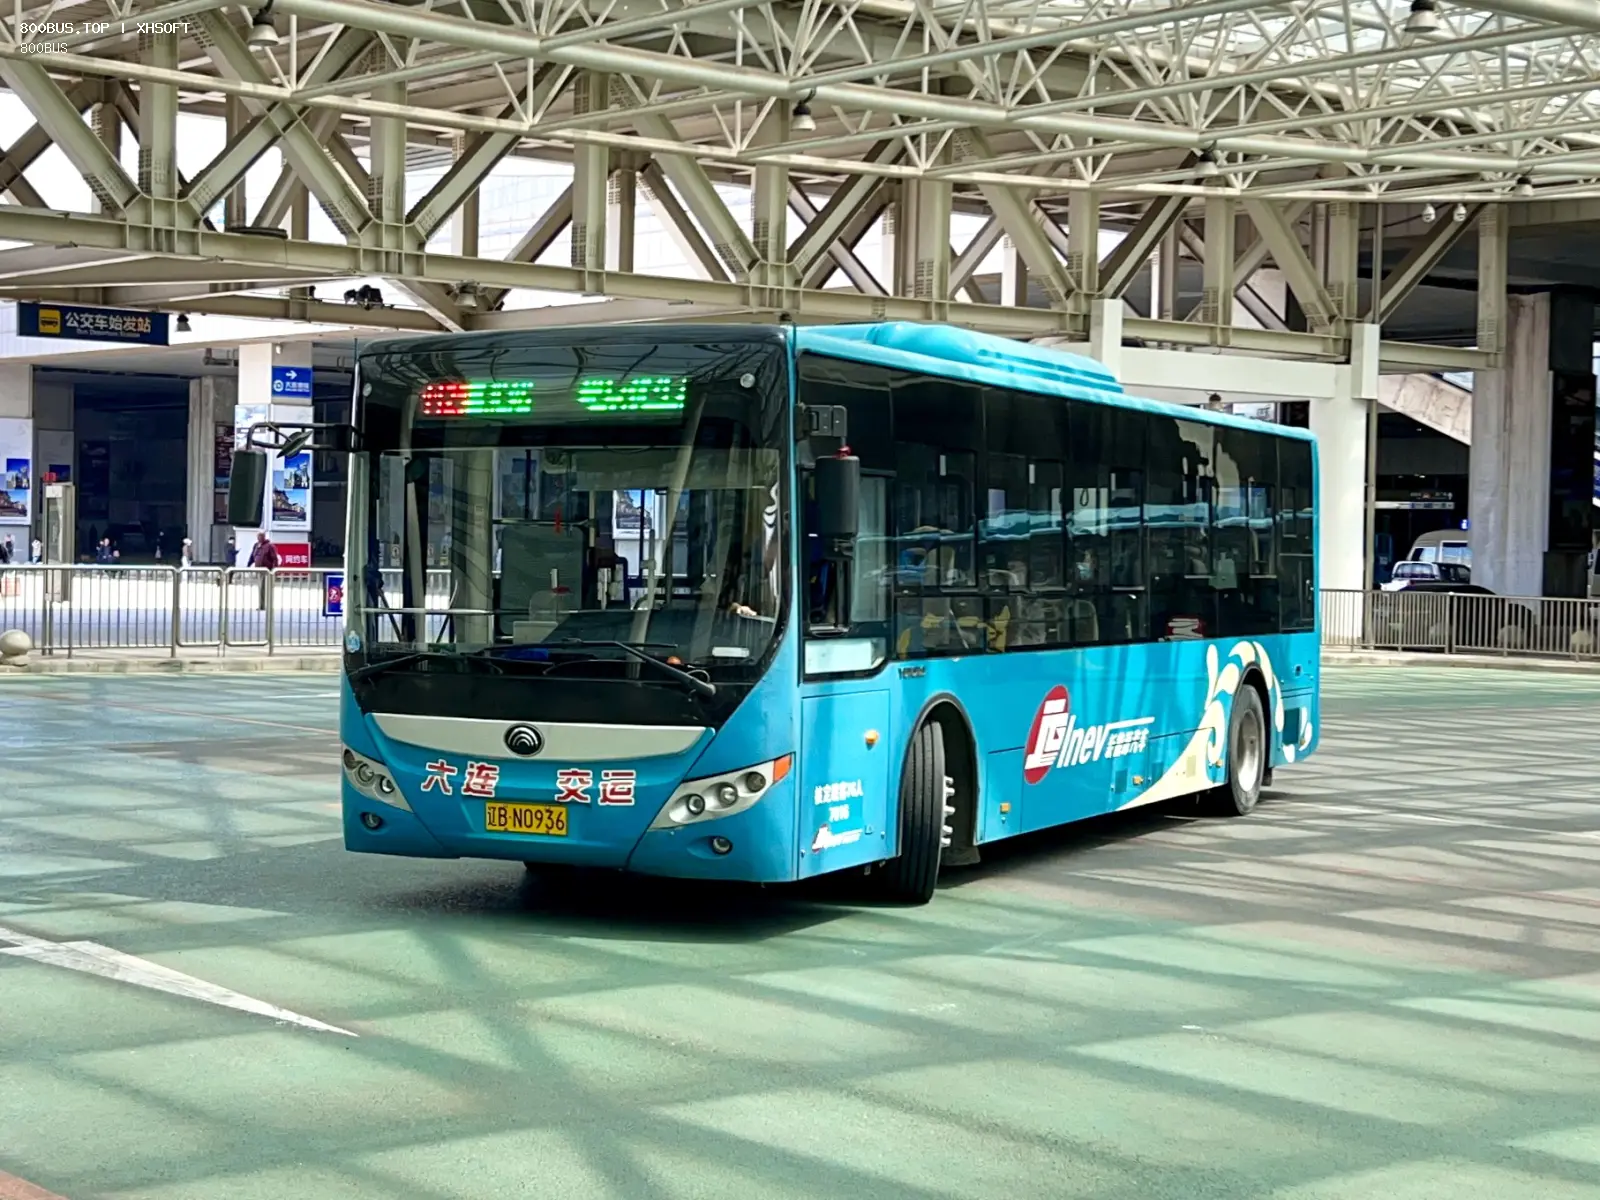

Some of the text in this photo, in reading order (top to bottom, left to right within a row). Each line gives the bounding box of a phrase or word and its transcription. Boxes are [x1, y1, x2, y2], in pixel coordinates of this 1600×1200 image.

[65, 311, 152, 333] 公交车始发站
[555, 768, 636, 807] 交运
